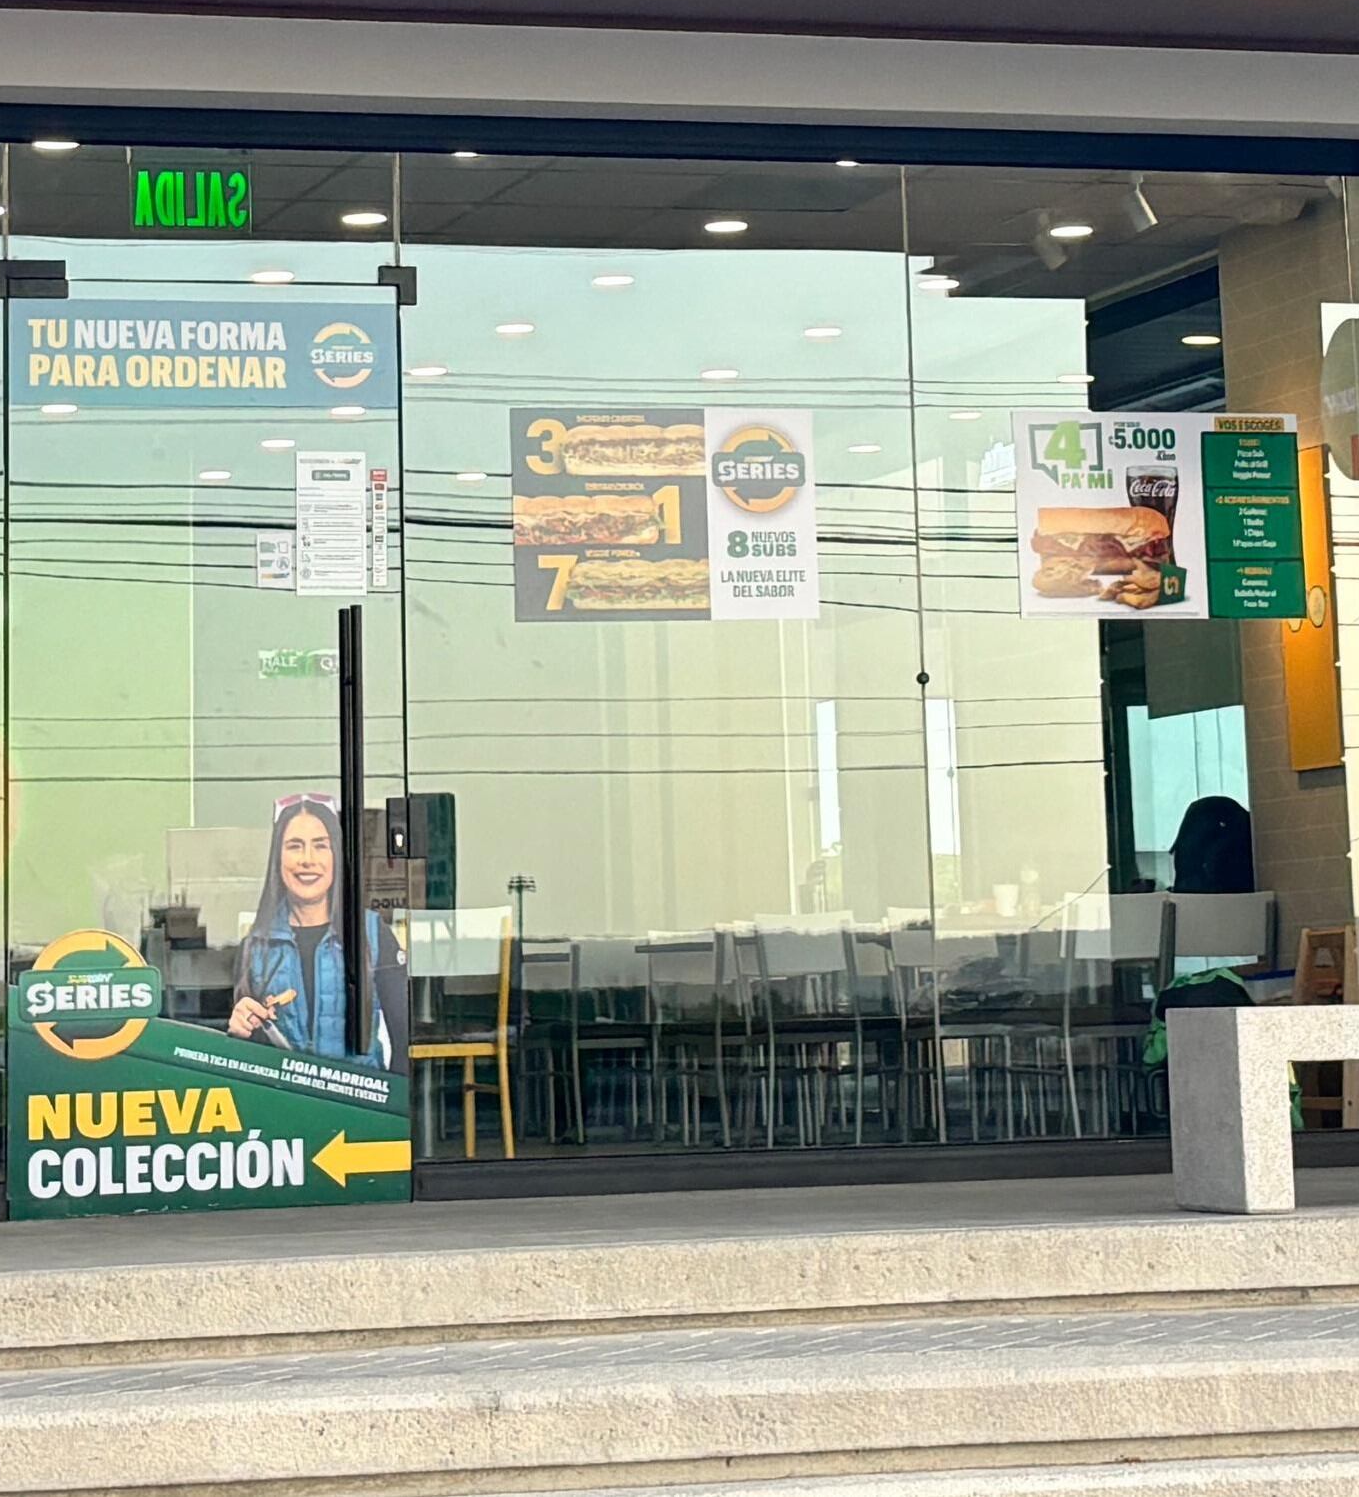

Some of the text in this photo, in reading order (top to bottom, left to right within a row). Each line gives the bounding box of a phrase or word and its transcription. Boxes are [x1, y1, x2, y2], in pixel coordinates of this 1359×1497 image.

[28, 320, 287, 352] TU NUEVA FORMA
[310, 348, 374, 364] SERIES
[28, 356, 287, 389] PARA ORDENAR
[526, 418, 568, 475] 3
[1044, 420, 1086, 469] 4
[718, 459, 800, 482] SERIES
[653, 485, 682, 545] 1
[727, 530, 749, 558] 8
[751, 531, 796, 544] NUEVOS
[751, 544, 797, 557] SUBS
[537, 554, 578, 611] 7
[721, 570, 735, 583] LA
[736, 570, 774, 583] NUEVA
[733, 585, 795, 598] DEL SABOR
[27, 980, 153, 1016] SERIES
[174, 1047, 209, 1063] PRIMERA
[320, 1067, 390, 1093] MADRIGAL
[28, 1087, 243, 1140] NUEVA
[28, 1128, 304, 1200] COLECCIÓN
